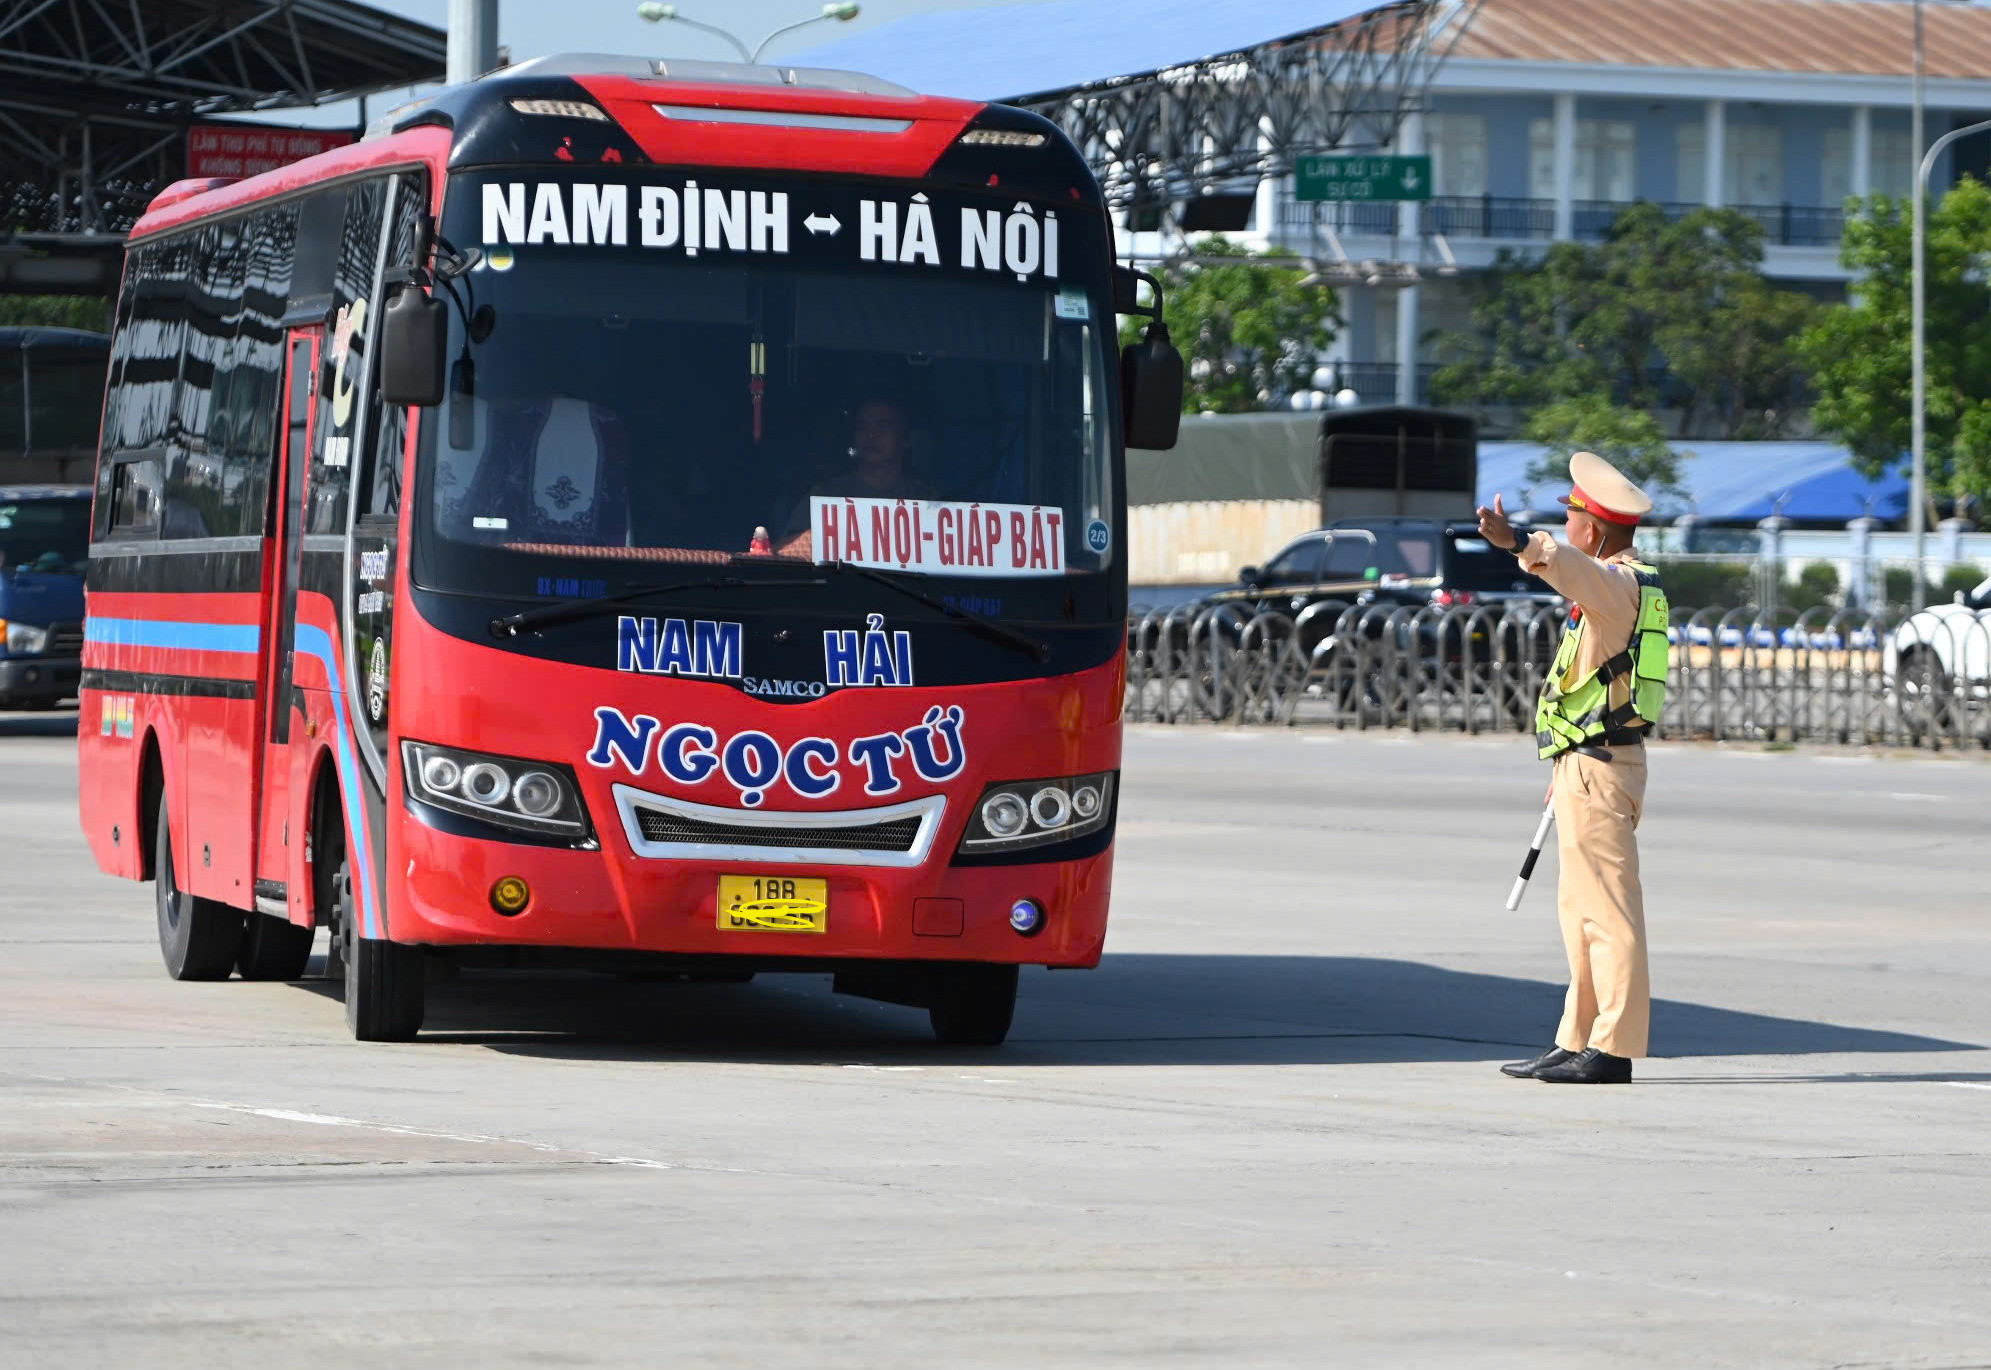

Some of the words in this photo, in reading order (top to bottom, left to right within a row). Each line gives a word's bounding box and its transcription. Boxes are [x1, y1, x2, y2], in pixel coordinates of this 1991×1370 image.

[482, 182, 627, 245] NAM
[638, 180, 789, 256] ĐỊNH
[961, 201, 1058, 282] NỘI
[821, 497, 864, 562] HÀ
[1010, 505, 1061, 570] BÁT
[1090, 529, 1106, 544] 2/3
[618, 615, 742, 678] NAM
[823, 612, 913, 687] HẢI
[743, 676, 826, 697] SAMCO
